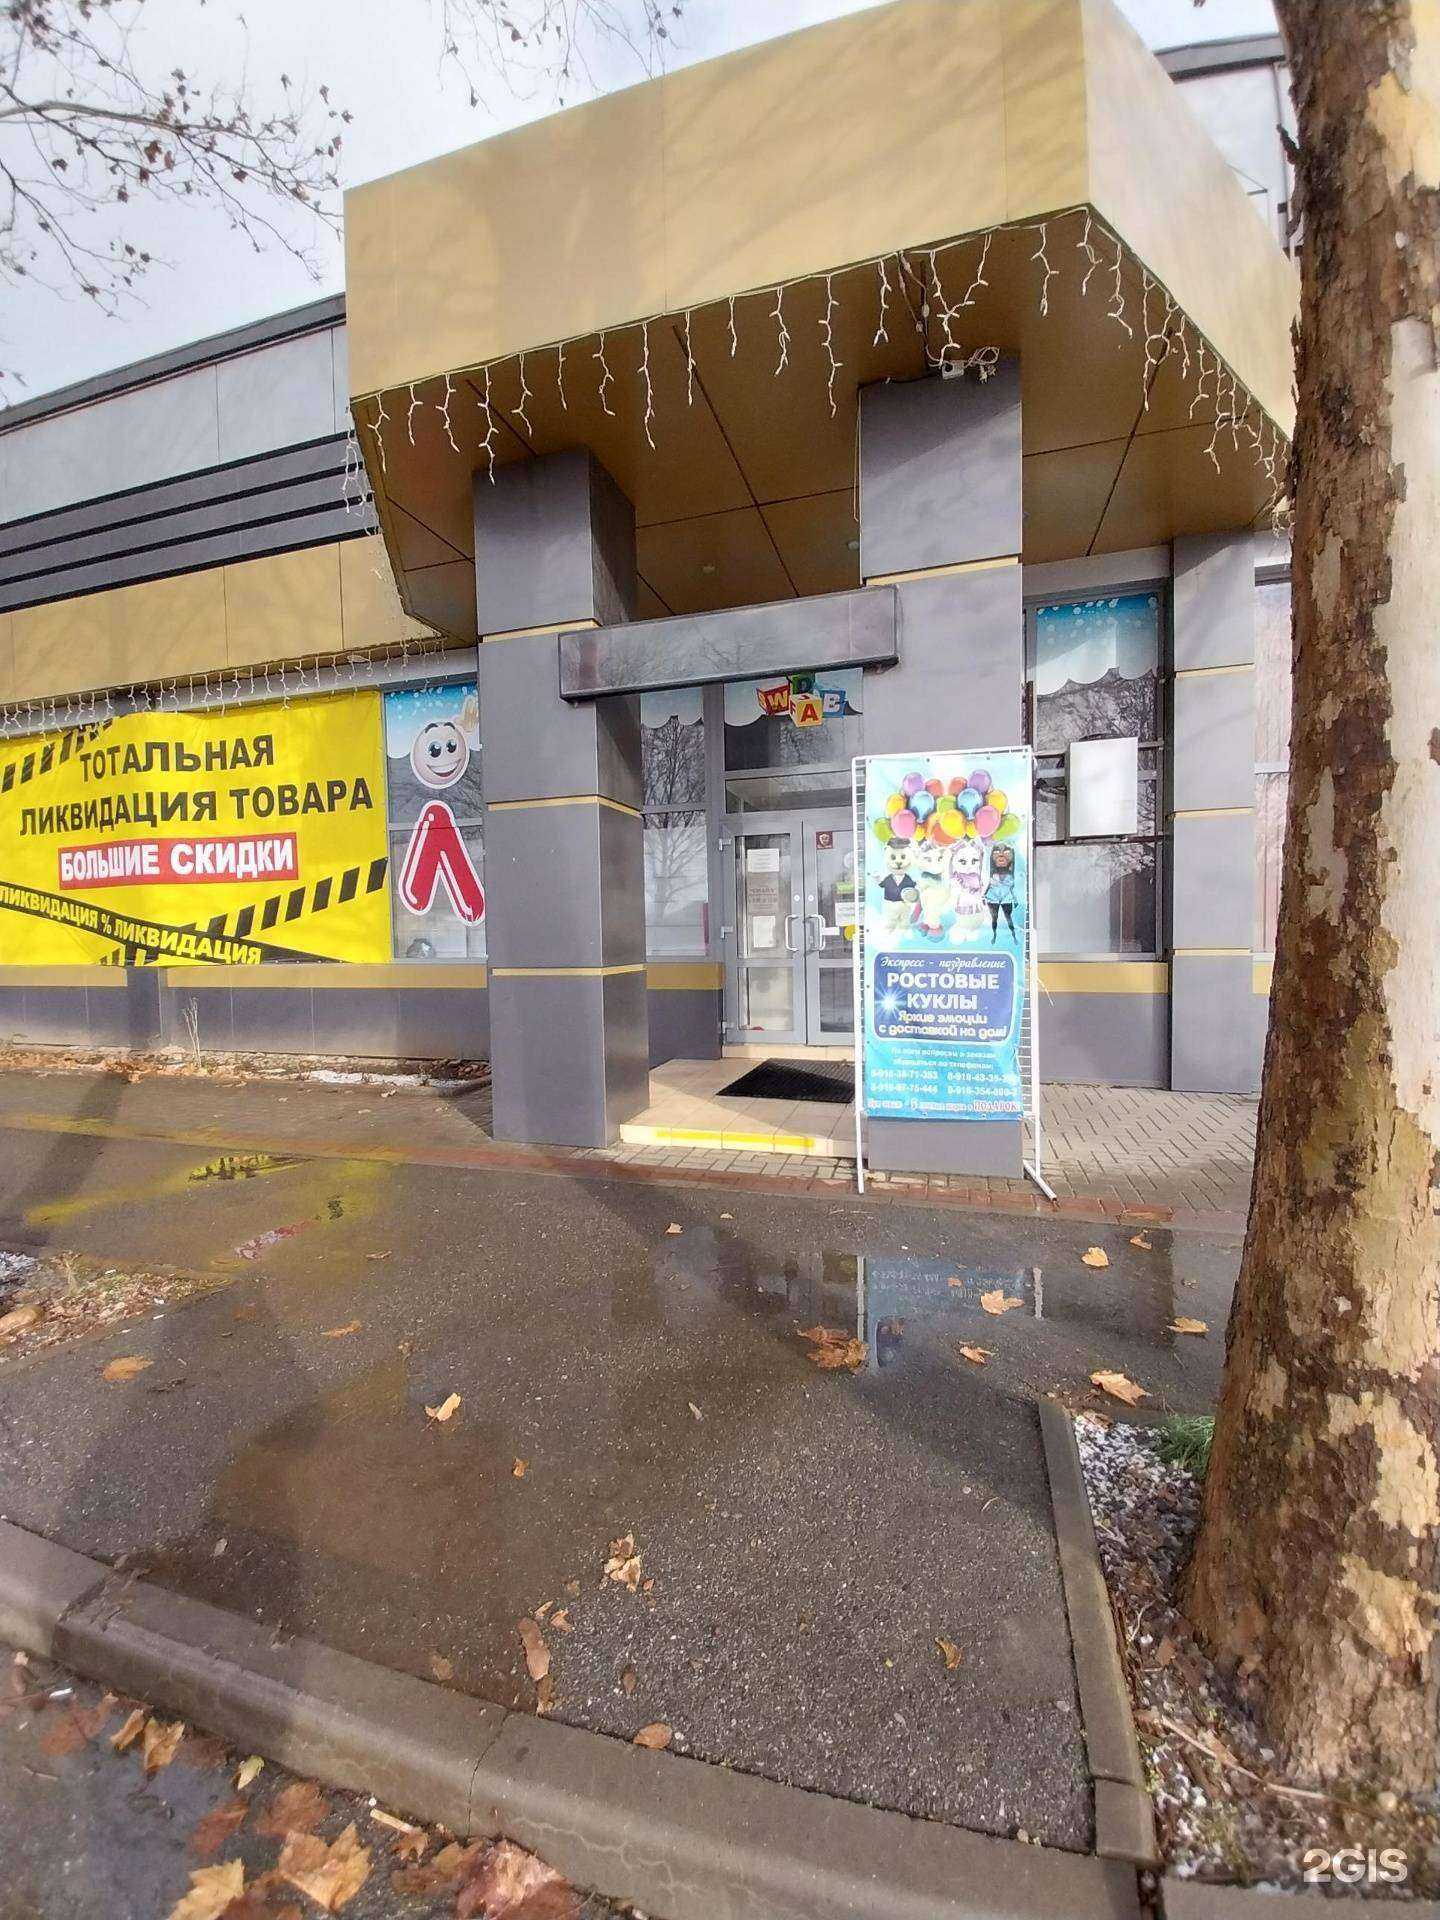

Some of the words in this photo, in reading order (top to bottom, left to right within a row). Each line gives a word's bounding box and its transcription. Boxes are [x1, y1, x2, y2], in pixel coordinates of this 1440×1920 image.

[80, 734, 274, 782] ТОТАЛЬНАЯ
[20, 791, 217, 836] ЛИКВИДАЦИЯ
[230, 777, 373, 819] ТОВАРА
[60, 844, 160, 882] БОЛЬШИЕ
[170, 839, 294, 879] СКИДКИ
[114, 920, 263, 965] ЛИКВИДАЦИЯ
[887, 972, 1000, 989] РОСТОВЫЕ
[907, 993, 978, 1010] КУКЛЫ
